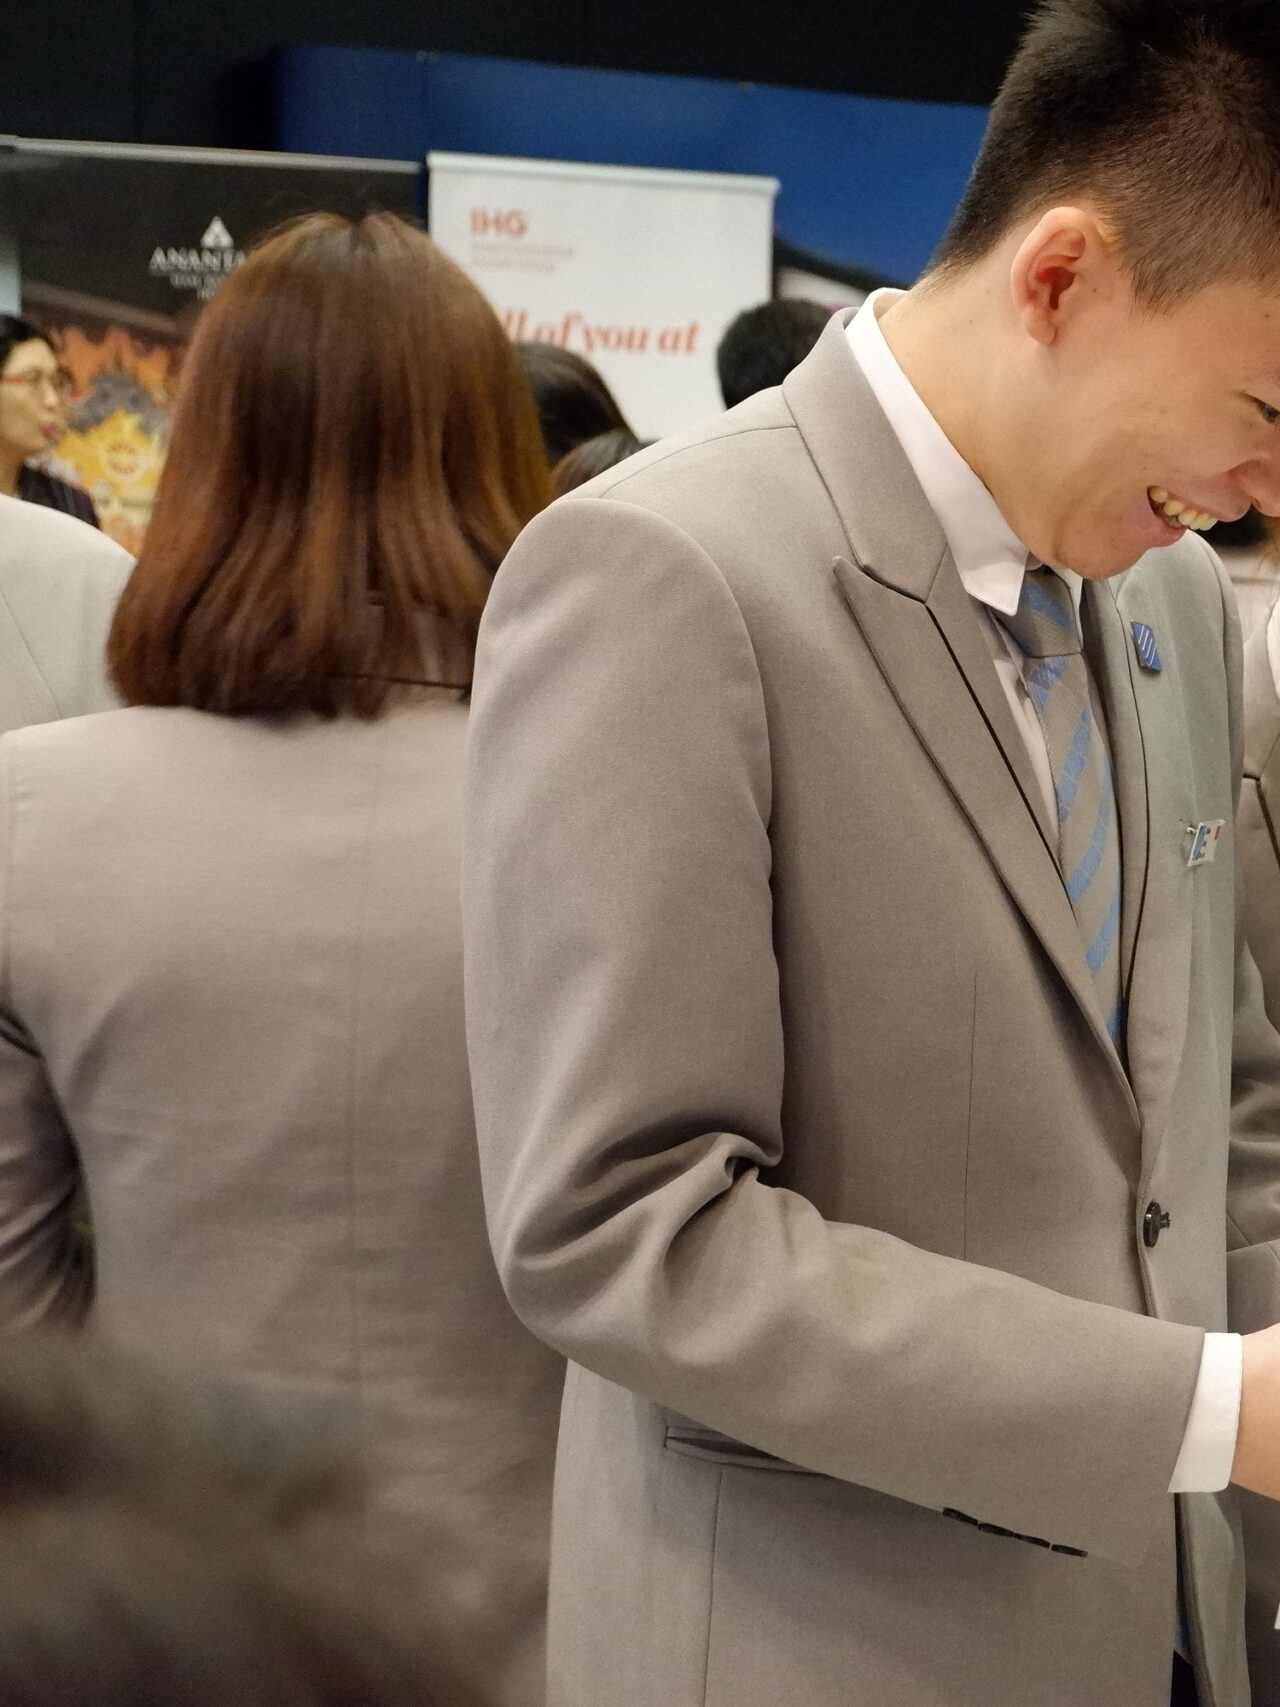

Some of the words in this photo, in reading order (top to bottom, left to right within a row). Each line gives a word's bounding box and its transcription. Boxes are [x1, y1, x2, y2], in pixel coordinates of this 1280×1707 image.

[469, 208, 528, 239] IHG
[535, 311, 581, 349] of
[582, 324, 649, 355] you
[656, 319, 700, 354] at
